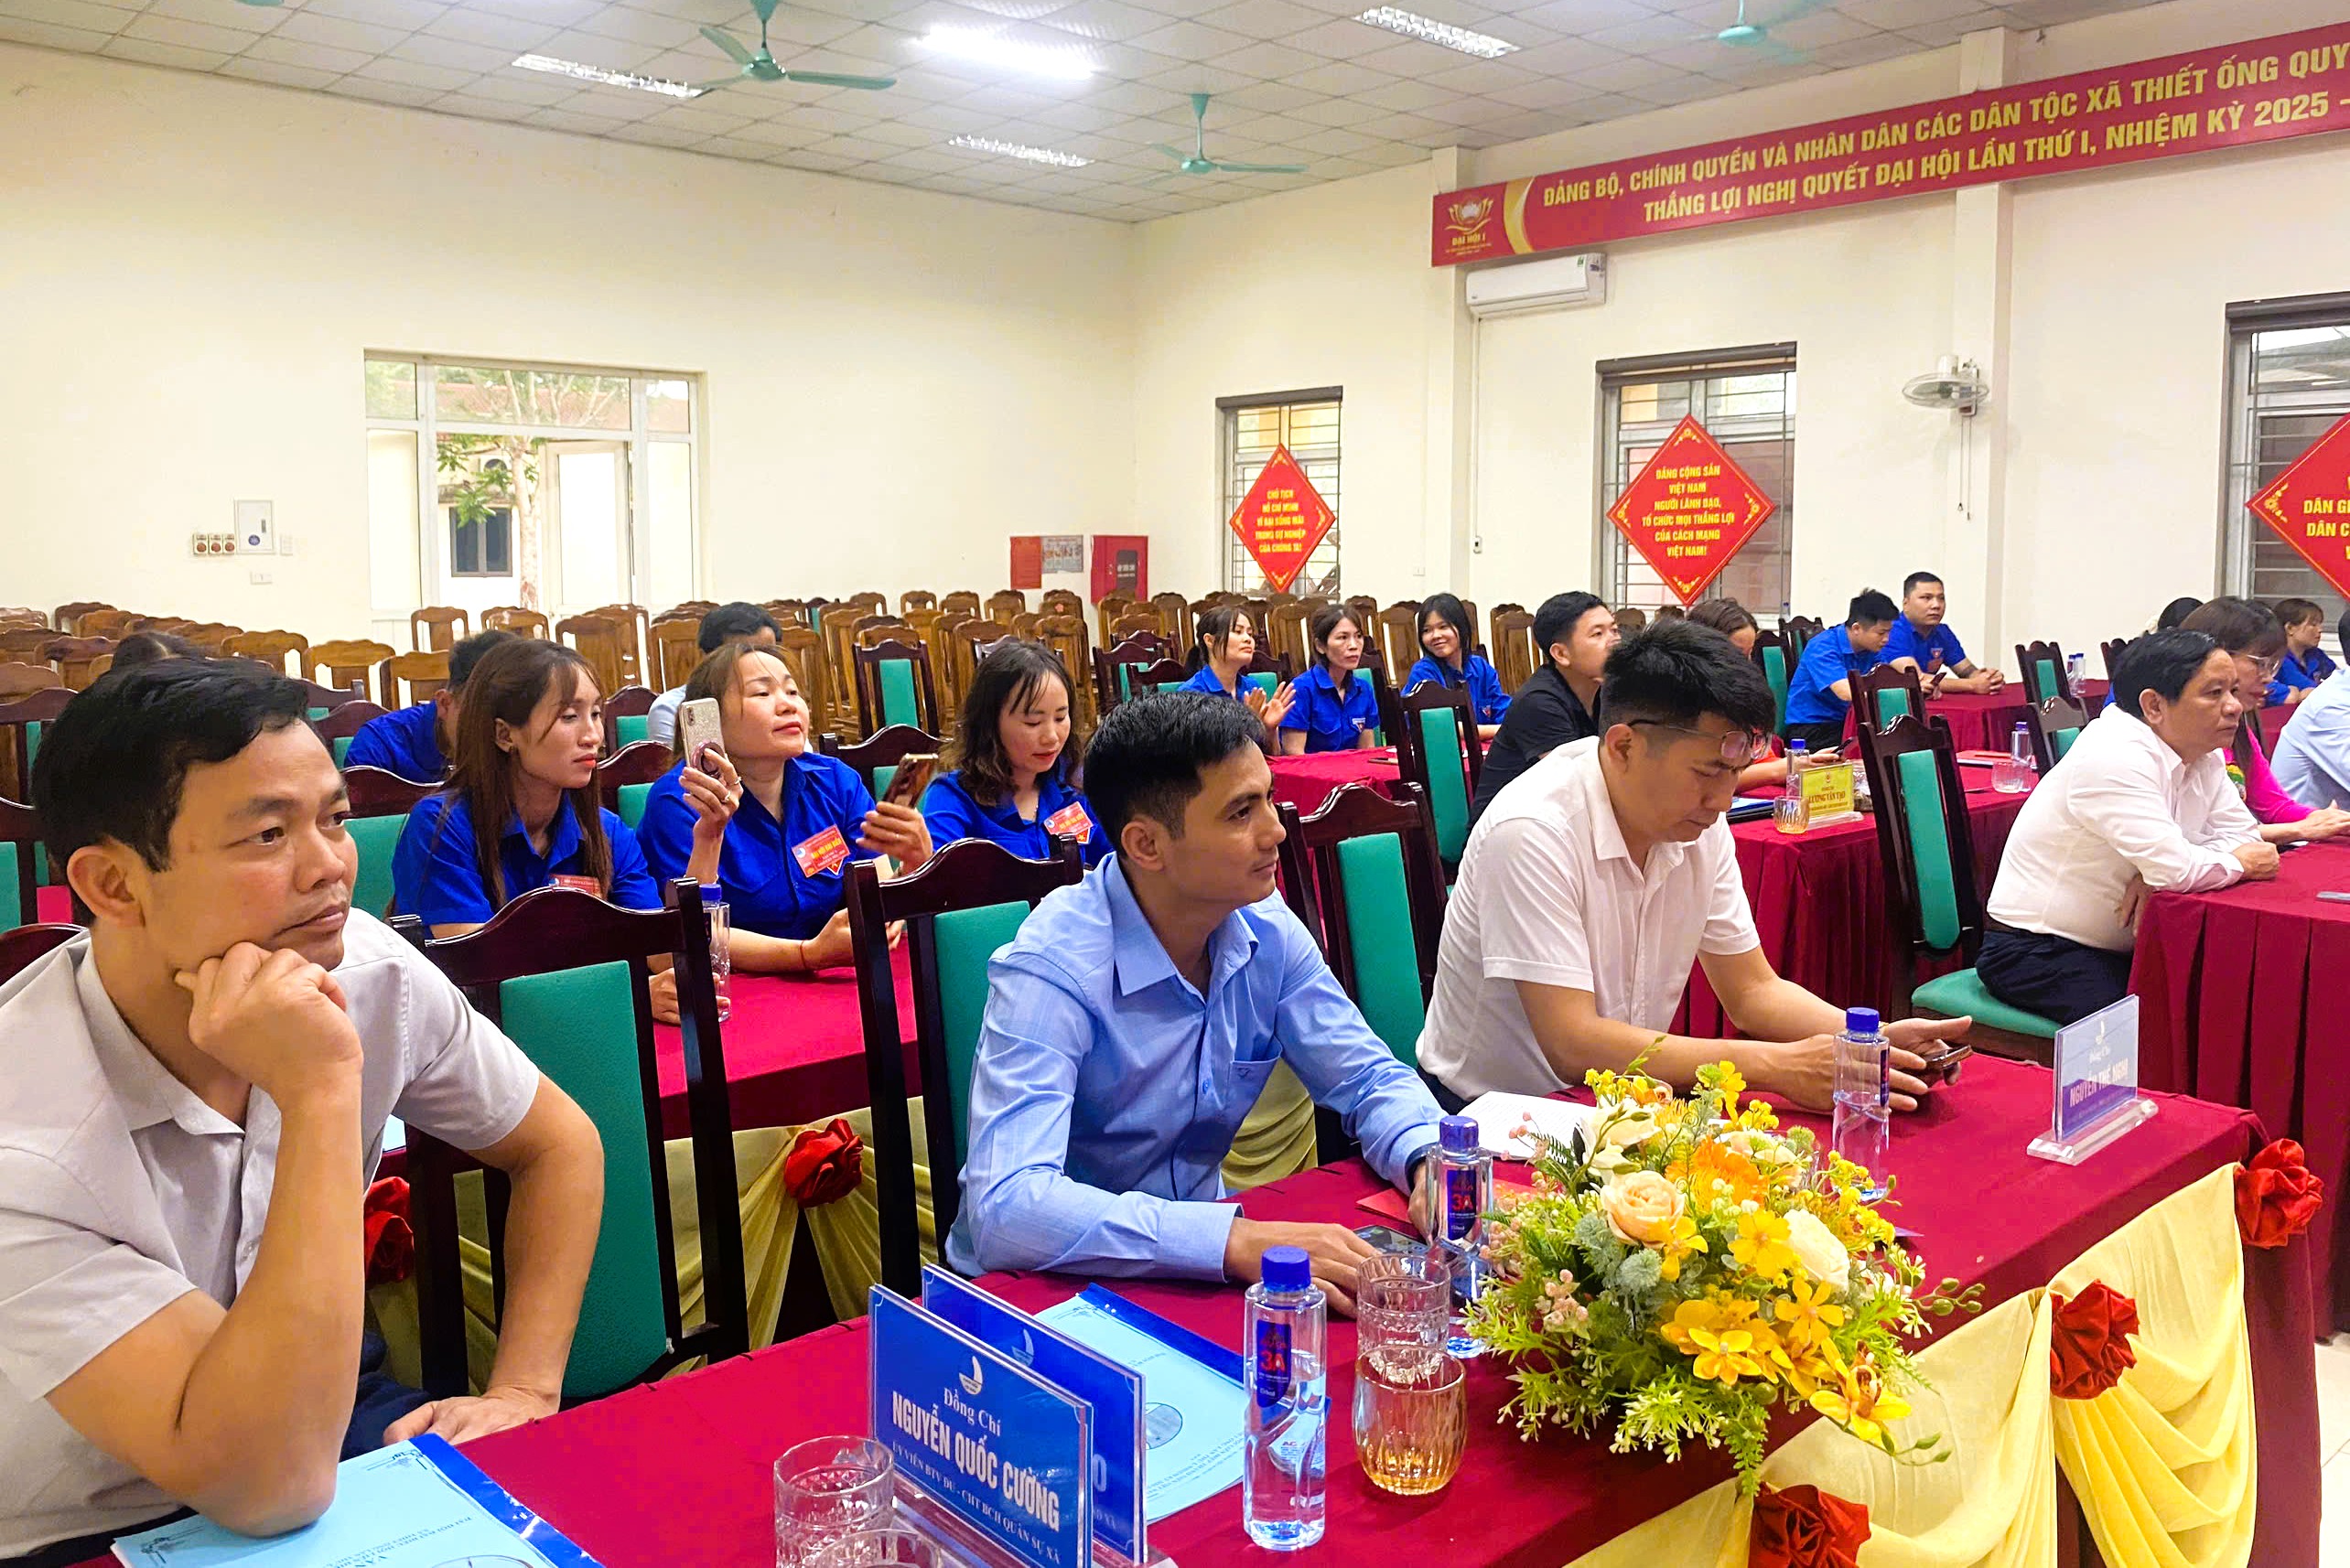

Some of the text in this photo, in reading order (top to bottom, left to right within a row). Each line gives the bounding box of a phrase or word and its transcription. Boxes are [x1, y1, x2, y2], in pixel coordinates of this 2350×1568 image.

[1544, 42, 2350, 207] ĐẢNG BỘ, CHÍNH QUYỀN VÀ NHÂN DÂN CÁC DÂN TỘC XÃ THIẾT ỐNG QUY
[1644, 190, 1705, 222] THẮNG
[1710, 186, 1741, 217] LỢI
[1748, 179, 1796, 209] NGHỊ
[1802, 162, 1870, 200] QUYẾT
[1875, 157, 1913, 188] ĐẠI
[1920, 146, 1960, 181] HỘI
[1967, 137, 2015, 171] LẦN
[2023, 128, 2075, 161] THỨ
[2080, 129, 2097, 156] I,
[2107, 112, 2197, 150] NHIỆM
[2207, 101, 2247, 134] KỲ
[2253, 91, 2329, 128] 2025
[1655, 461, 1720, 479] ĐẢNG CỘNG SẢN
[1668, 482, 1707, 496] VIỆT NAM
[1680, 497, 1701, 510] LÃNH
[2303, 497, 2334, 514] DÂN
[1653, 513, 1674, 527] CHỨC
[1676, 514, 1692, 527] MỌI
[1694, 510, 1719, 524] THẮNG
[1655, 528, 1720, 542] CỦA CÁCH MẠNG
[2306, 520, 2336, 537] DÂN
[1666, 544, 1683, 559] VIỆT
[943, 1388, 1002, 1437] Đồng Chí
[892, 1391, 1060, 1532] NGUYỄN QUỐC CƯỜNG
